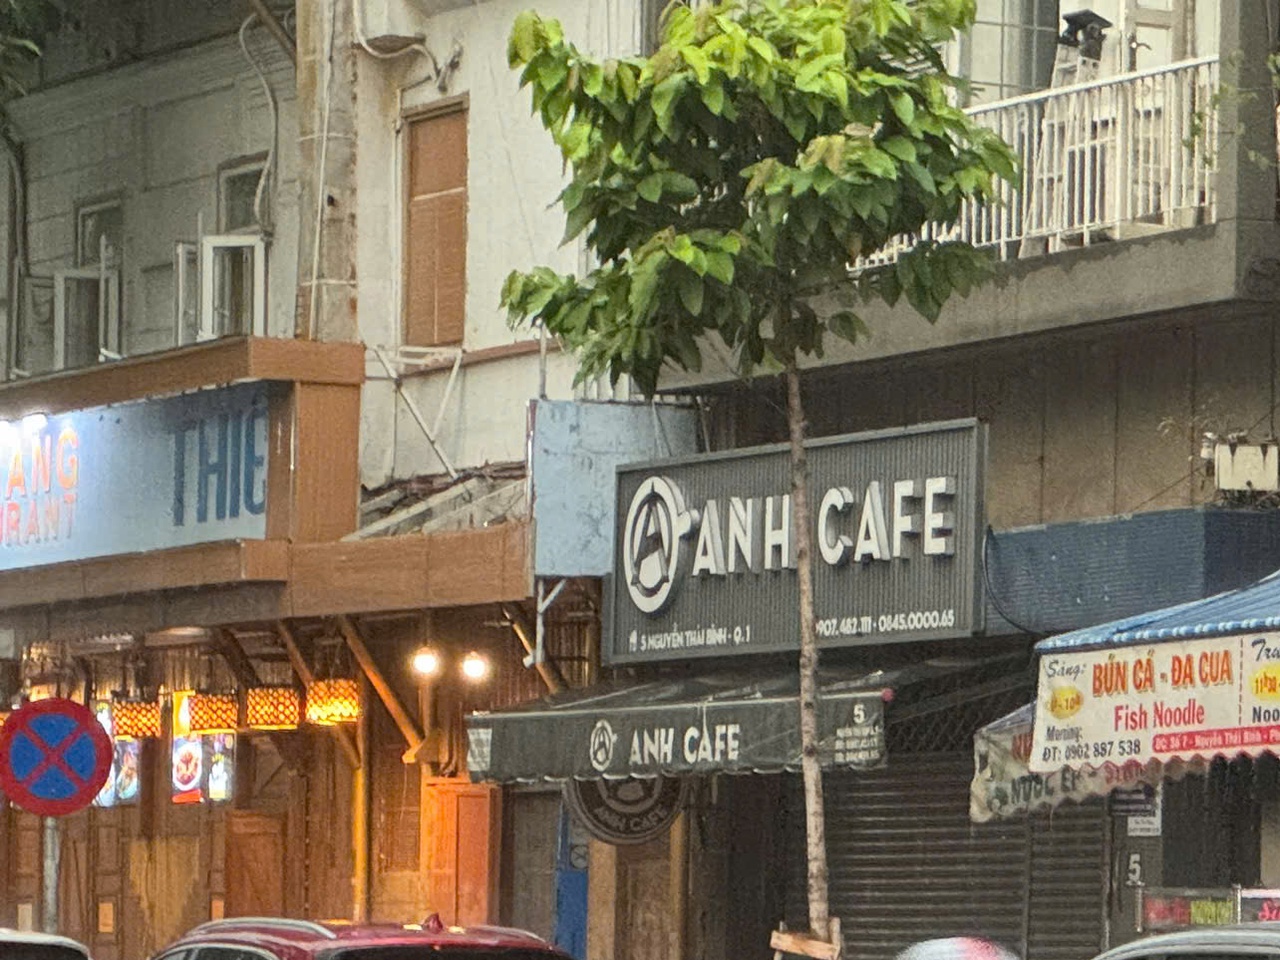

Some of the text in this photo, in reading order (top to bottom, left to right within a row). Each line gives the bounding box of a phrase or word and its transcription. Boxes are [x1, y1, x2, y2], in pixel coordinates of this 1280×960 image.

[0, 493, 77, 547] RANT
[692, 476, 955, 576] ANH CAFE
[1092, 653, 1128, 697] BÚN
[1132, 649, 1156, 692] CÁ
[1171, 653, 1195, 687] ĐA
[1198, 650, 1234, 685] CUA
[853, 703, 865, 724] 5
[1114, 699, 1205, 731] Fish Noodle
[629, 723, 740, 766] ANH CAFE
[1065, 743, 1090, 760] 0902
[1093, 741, 1114, 757] 887
[1118, 739, 1141, 755] 538
